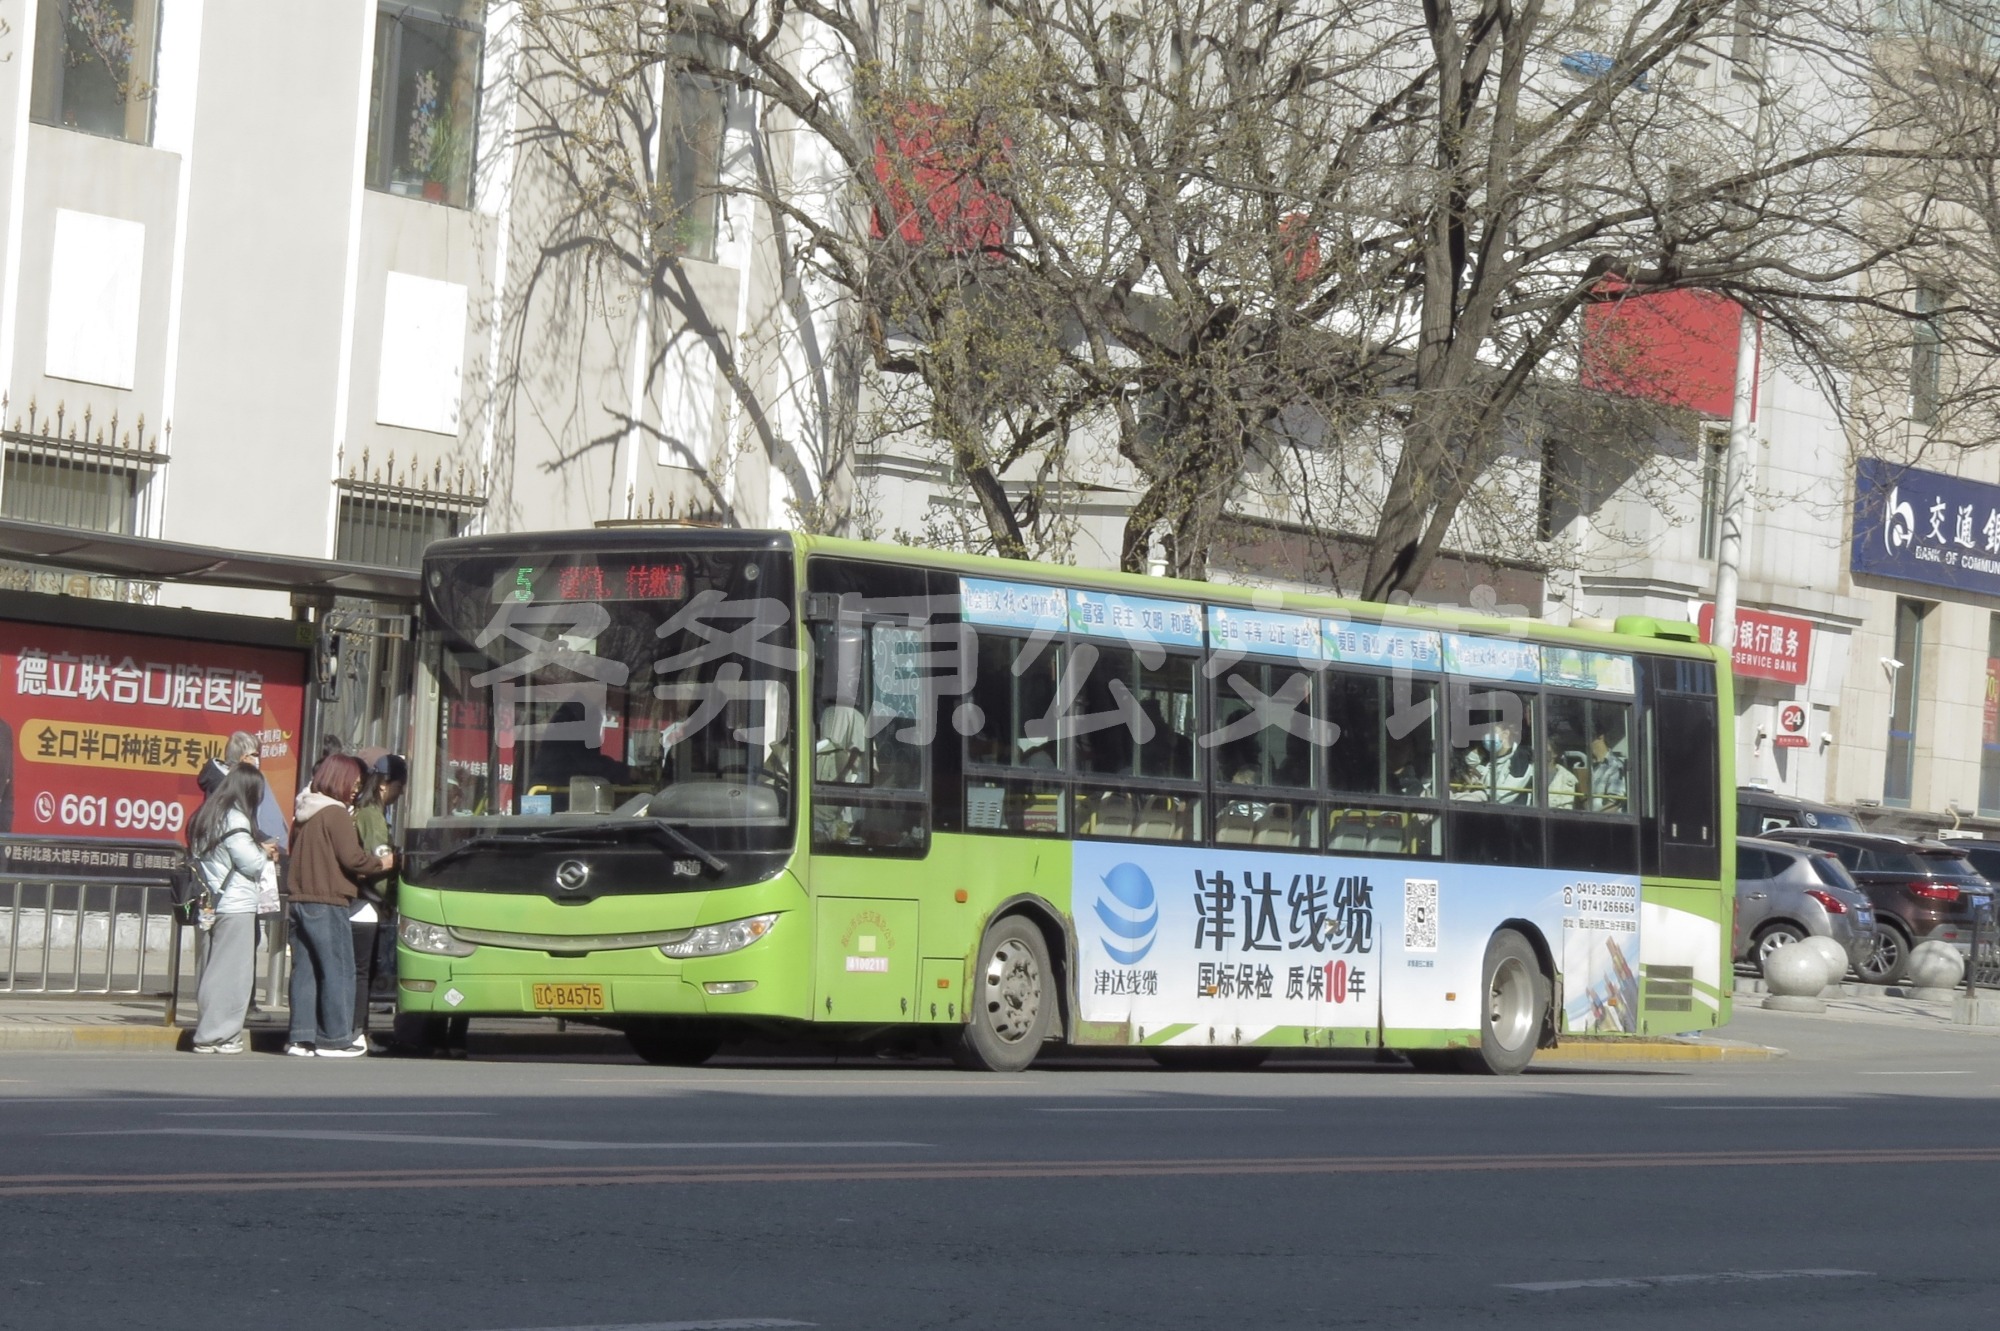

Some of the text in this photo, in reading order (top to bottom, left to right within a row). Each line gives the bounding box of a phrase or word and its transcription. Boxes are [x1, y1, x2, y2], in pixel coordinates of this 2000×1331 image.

[1915, 545, 1941, 562] BANK
[1945, 551, 1958, 565] OF
[515, 567, 532, 601] 5
[1082, 602, 1193, 634] 富强 民主 文明 和谐
[1221, 619, 1238, 639] 自由
[1244, 620, 1262, 641] 平等
[1269, 623, 1286, 645] 公正
[1338, 631, 1356, 652] 爱国
[1774, 658, 1797, 673] BANK
[16, 646, 264, 716] 德立联合口腔医院
[1784, 710, 1802, 726] 24
[60, 793, 185, 833] 661 9999
[12, 846, 129, 868] 胜利北路大馆早市西口对面
[1577, 883, 1636, 898] 0412-8587000
[1194, 868, 1374, 955] 津达线缆
[1094, 969, 1159, 996] 津达线缆
[1197, 958, 1367, 1004] 国标保检 质保10年
